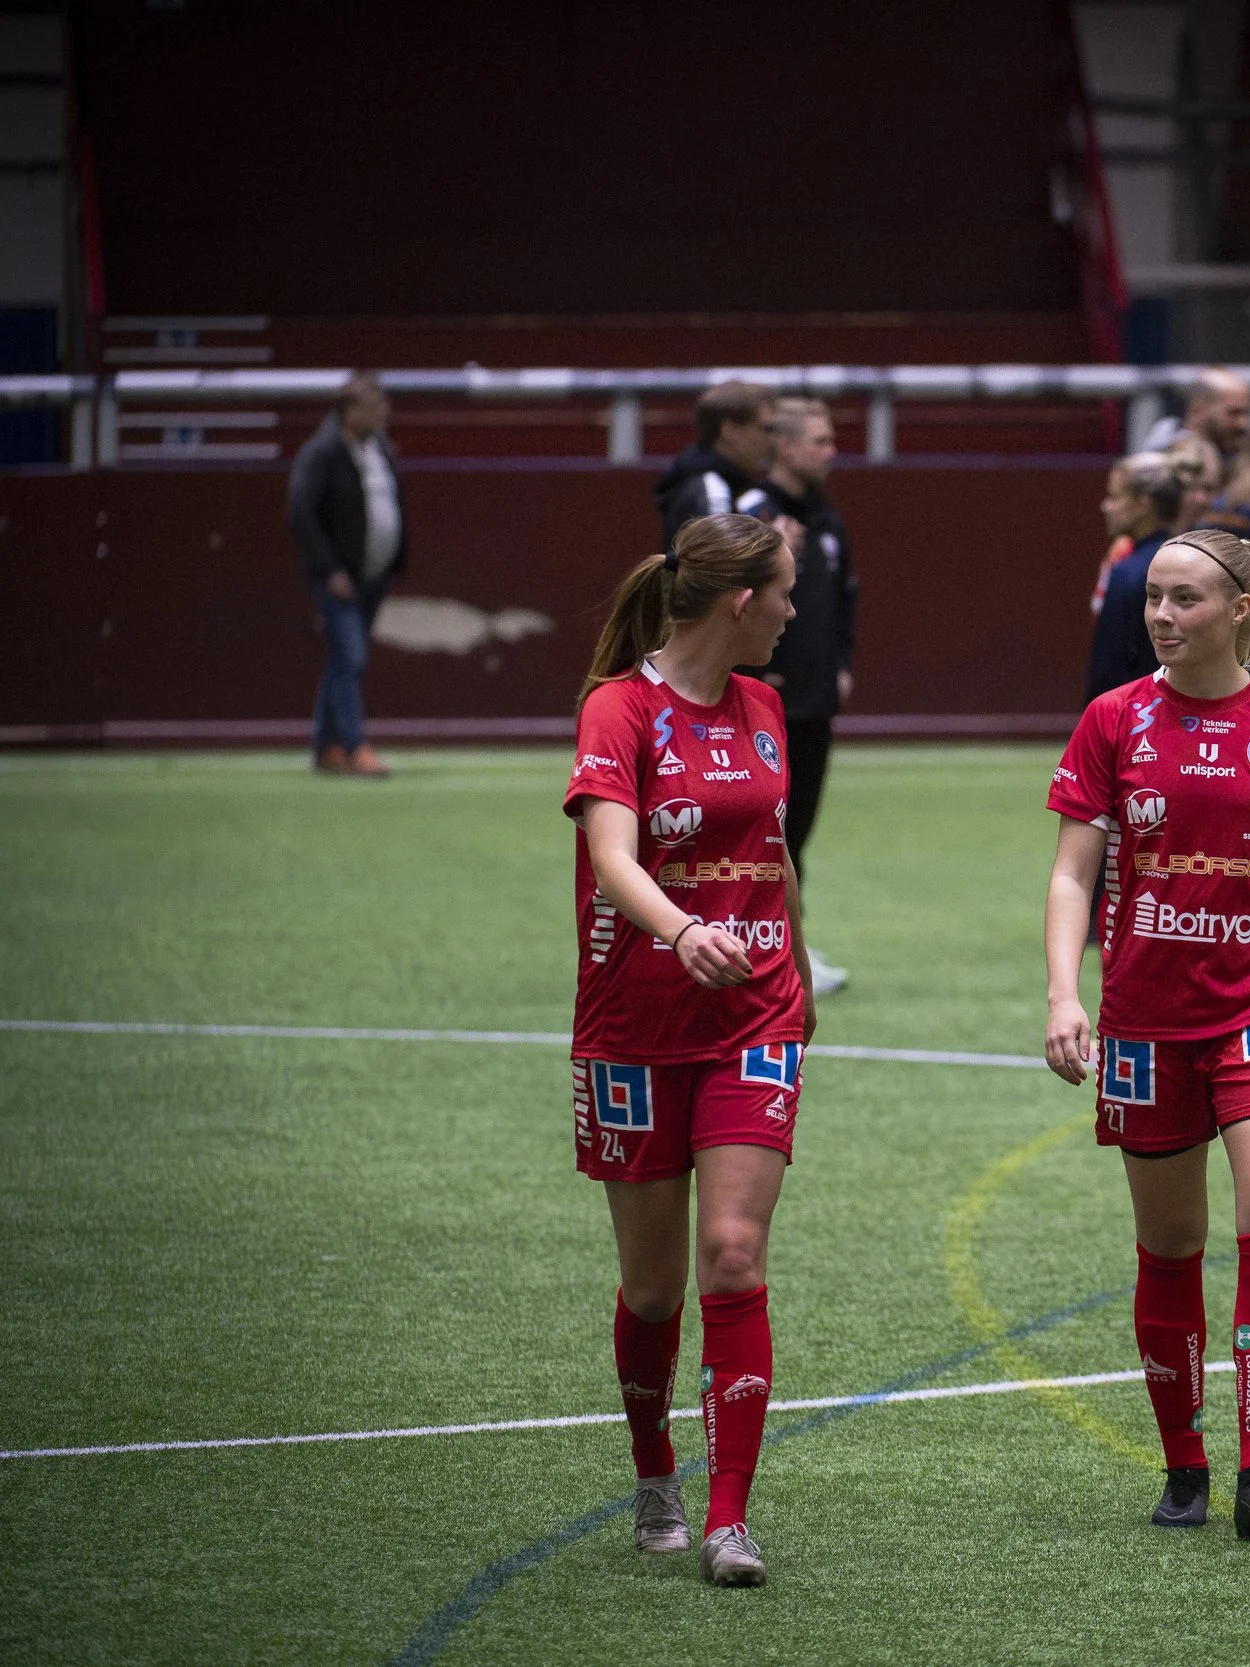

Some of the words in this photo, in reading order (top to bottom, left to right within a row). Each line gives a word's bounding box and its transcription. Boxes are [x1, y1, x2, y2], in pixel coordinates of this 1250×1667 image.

[1202, 719, 1236, 728] Tekniska
[1202, 726, 1229, 734] verken
[1131, 753, 1158, 764] SELECT
[657, 764, 686, 776] SELECT
[702, 769, 752, 783] unisport
[1180, 763, 1236, 779] unisport
[1104, 1103, 1125, 1135] 27
[600, 1131, 626, 1164] 24
